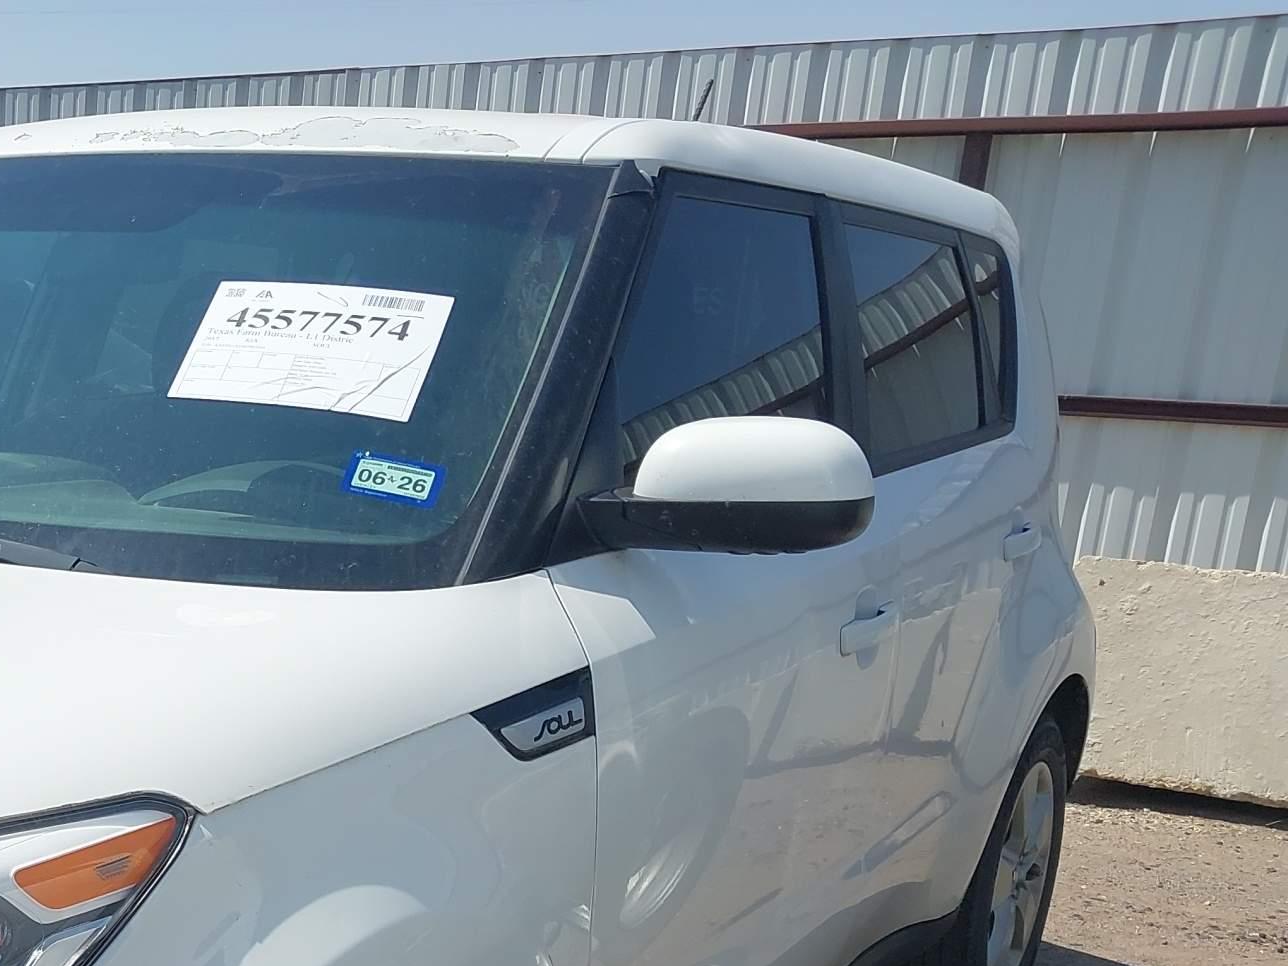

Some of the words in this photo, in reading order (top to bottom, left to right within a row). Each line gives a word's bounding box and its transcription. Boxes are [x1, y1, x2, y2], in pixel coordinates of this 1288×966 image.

[207, 328, 233, 336] Texas
[236, 328, 261, 337] Farm
[226, 306, 412, 341] 45577574
[358, 468, 388, 485] 06
[397, 476, 428, 494] 26
[533, 709, 584, 742] SOUL
